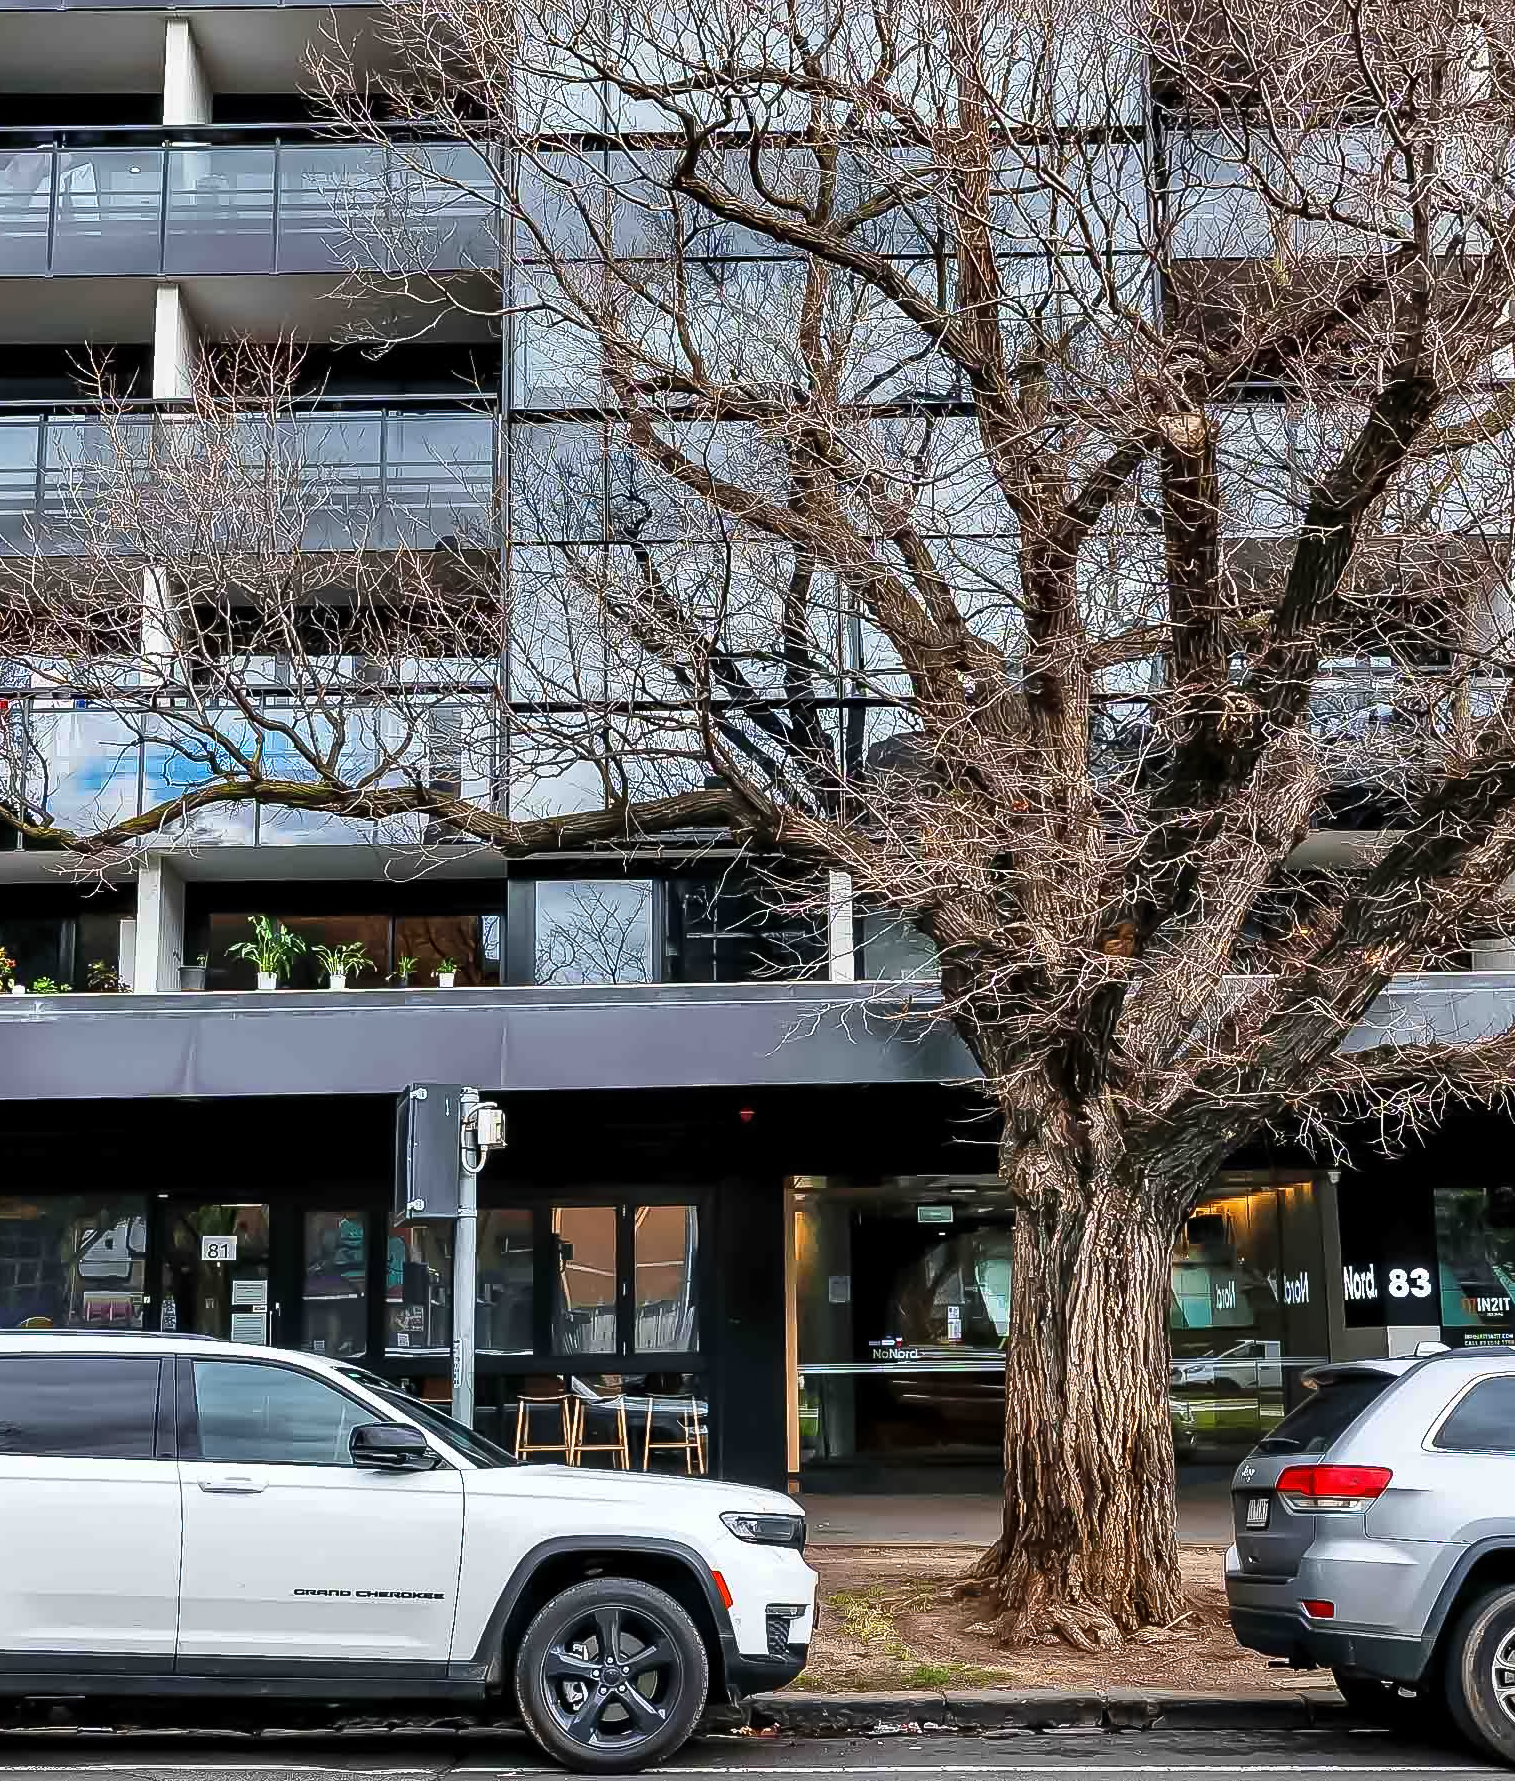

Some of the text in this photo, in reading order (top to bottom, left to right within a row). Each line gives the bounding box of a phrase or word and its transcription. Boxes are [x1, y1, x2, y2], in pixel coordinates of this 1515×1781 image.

[207, 1243, 229, 1259] 81
[1343, 1263, 1378, 1301] Nord.
[1388, 1267, 1432, 1298] 83
[293, 1588, 446, 1600] GRAND CHEROKEE
